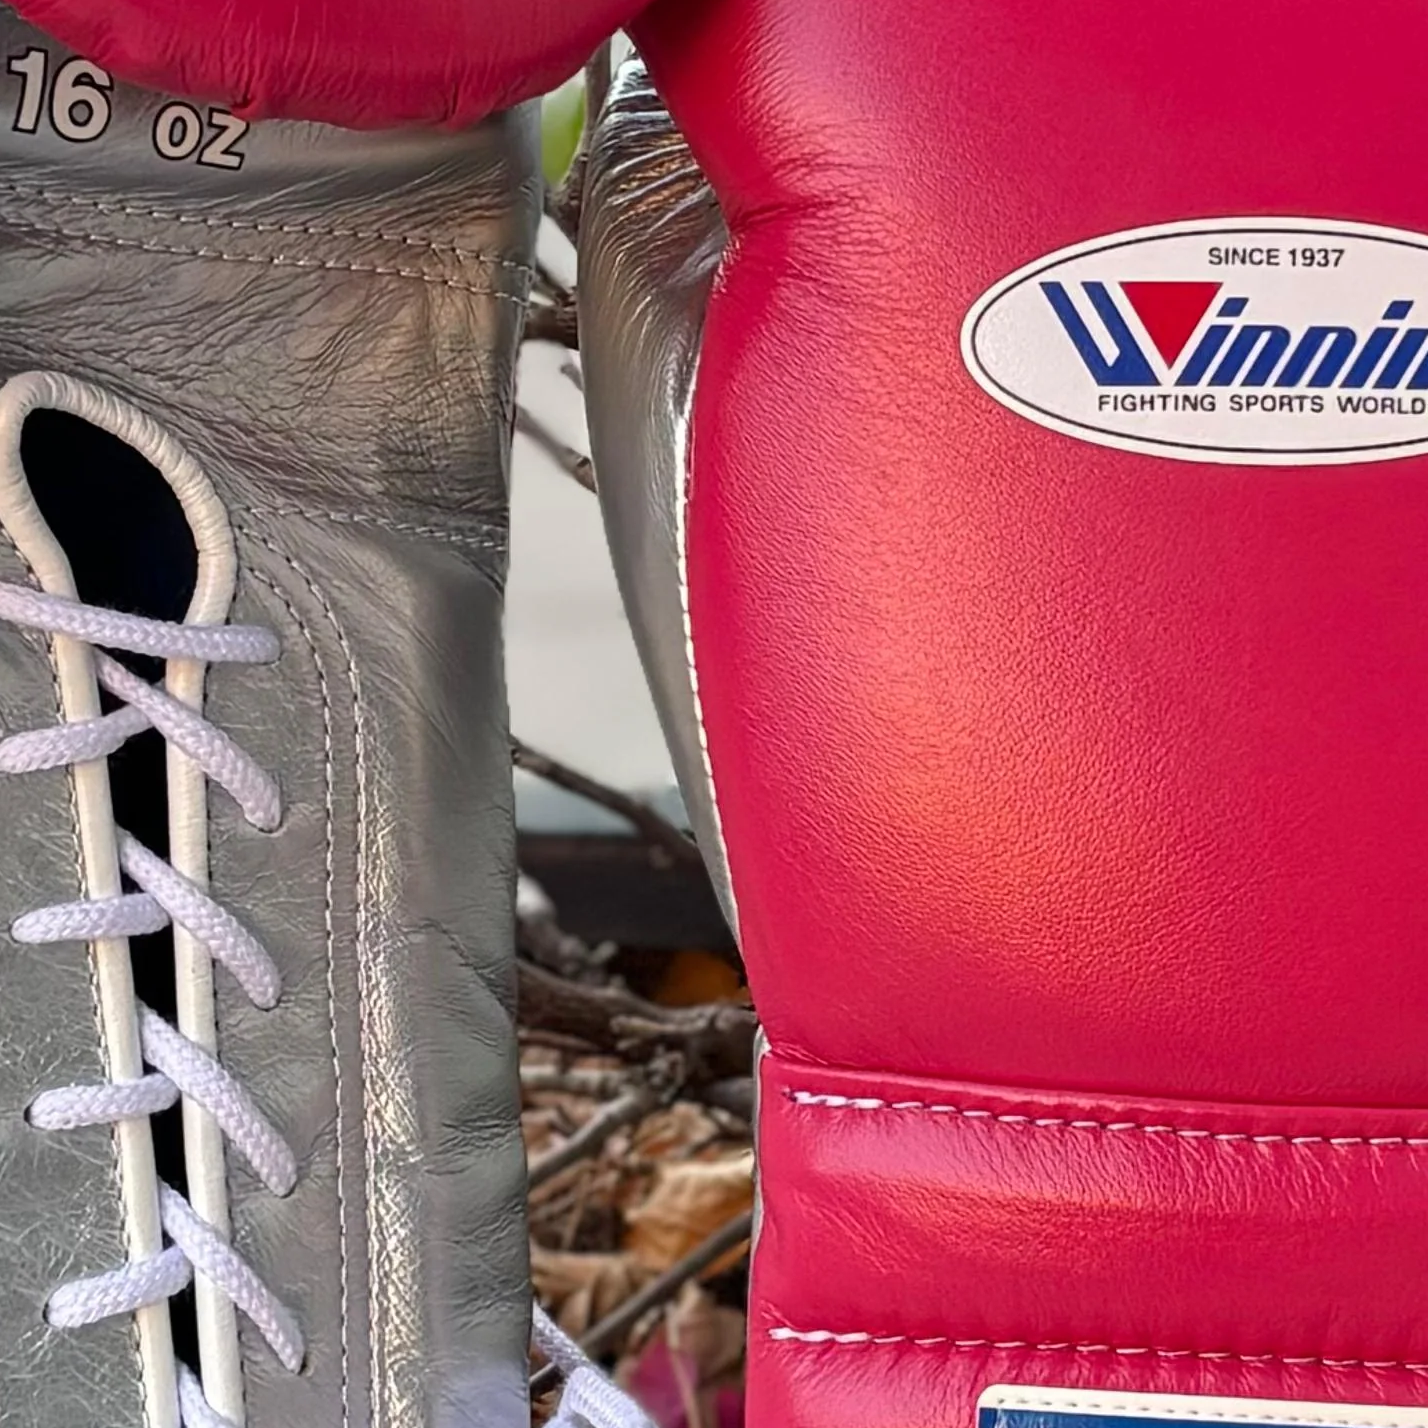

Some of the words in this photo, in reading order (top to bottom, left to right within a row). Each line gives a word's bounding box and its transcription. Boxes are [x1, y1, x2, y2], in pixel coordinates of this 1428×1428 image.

[7, 46, 114, 143] 16
[1208, 247, 1280, 266] SINCE
[1288, 248, 1345, 267] 1937
[1097, 394, 1217, 413] FIGHTING
[1229, 395, 1324, 414] SPORTS
[1336, 396, 1426, 416] WORLD
